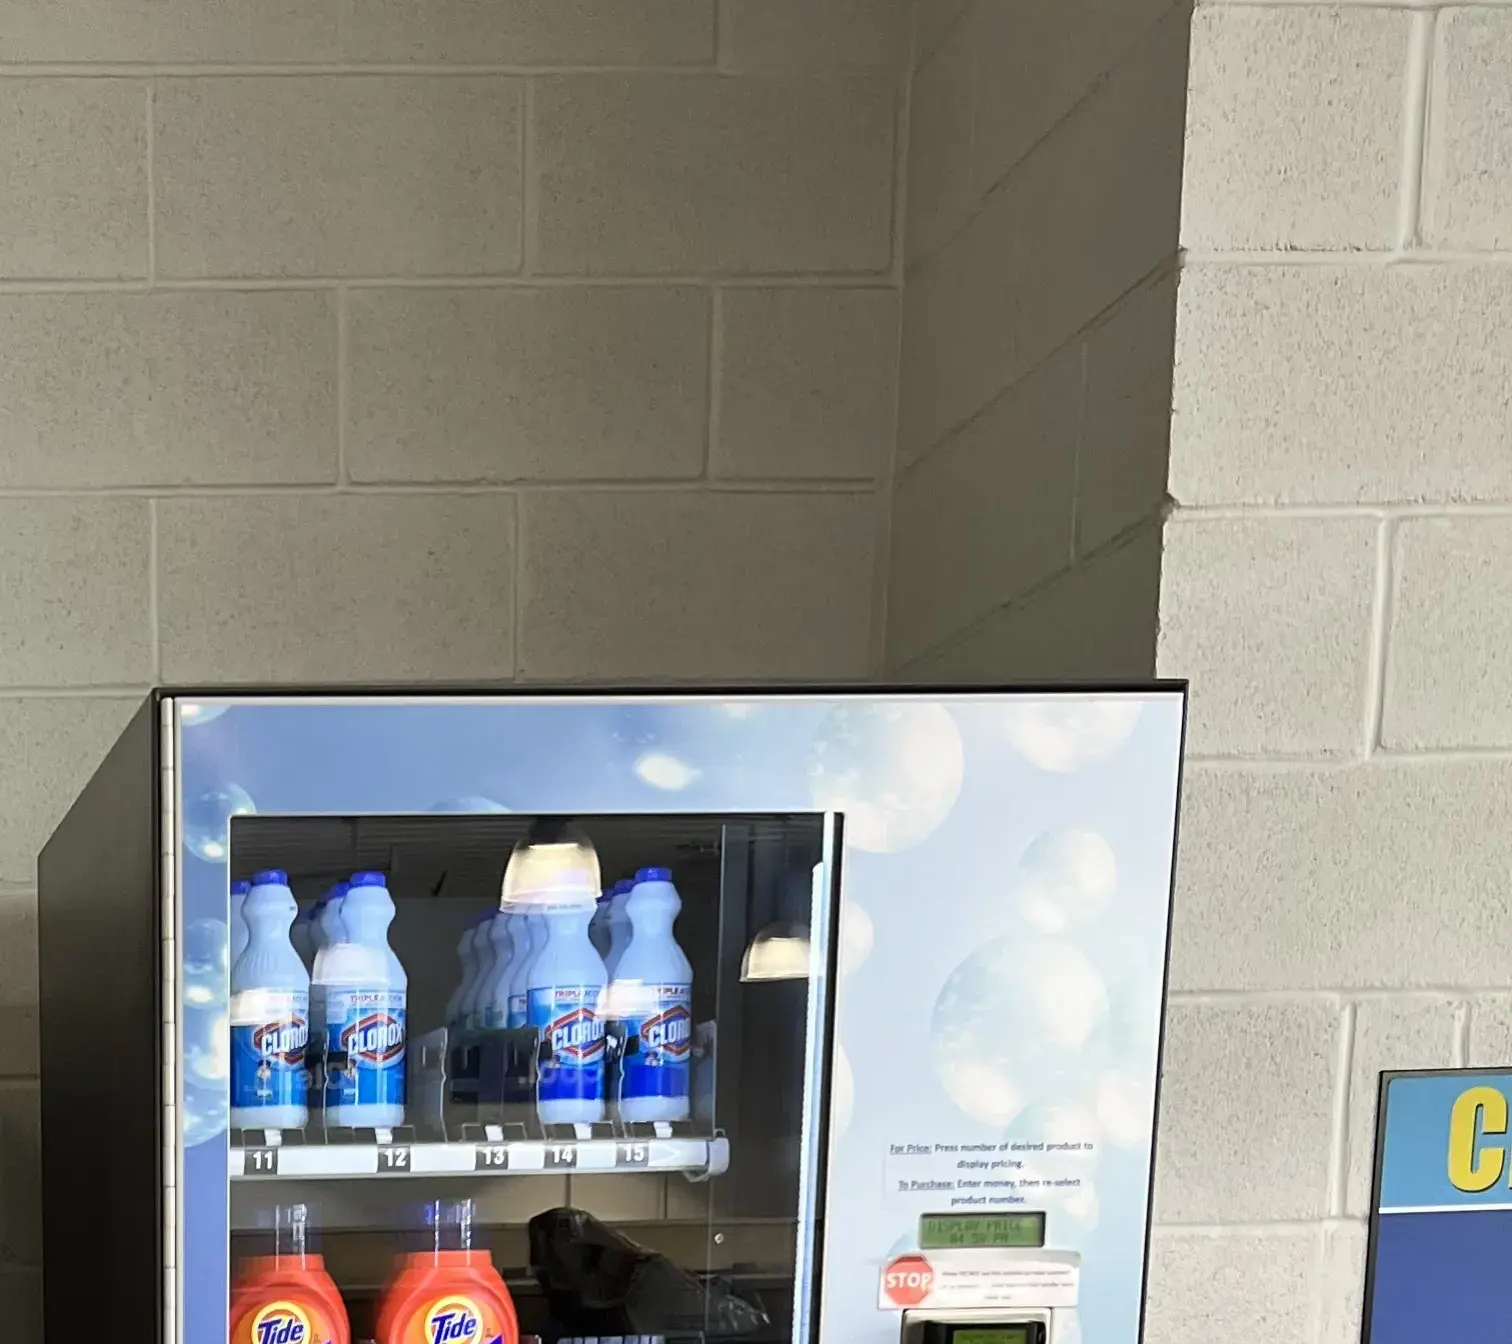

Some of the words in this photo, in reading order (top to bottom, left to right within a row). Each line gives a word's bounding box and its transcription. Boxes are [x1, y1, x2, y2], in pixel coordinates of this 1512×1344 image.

[348, 1020, 403, 1056] CLOROX
[482, 1146, 503, 1165] 13
[552, 1146, 573, 1164] 14
[623, 1144, 645, 1163] 15
[890, 1144, 905, 1154] For
[907, 1144, 932, 1154] Price:
[935, 1144, 958, 1152] Press
[960, 1144, 996, 1152] number
[999, 1143, 1008, 1151] of
[1010, 1143, 1044, 1151] desired
[1046, 1143, 1081, 1153] product
[1084, 1142, 1094, 1150] to
[253, 1151, 272, 1169] 11
[385, 1148, 406, 1167] 12
[957, 1160, 988, 1170] display
[991, 1159, 1024, 1170] pricing.
[898, 1180, 908, 1191] To
[911, 1180, 955, 1190] Purchase:
[957, 1179, 981, 1188] Enter
[983, 1180, 1017, 1189] money,
[1019, 1179, 1039, 1187] then
[1042, 1178, 1081, 1187] re-select
[951, 1196, 986, 1206] product
[989, 1196, 1026, 1204] number.
[928, 1219, 979, 1232] DISPLAY
[888, 1273, 932, 1288] STOP
